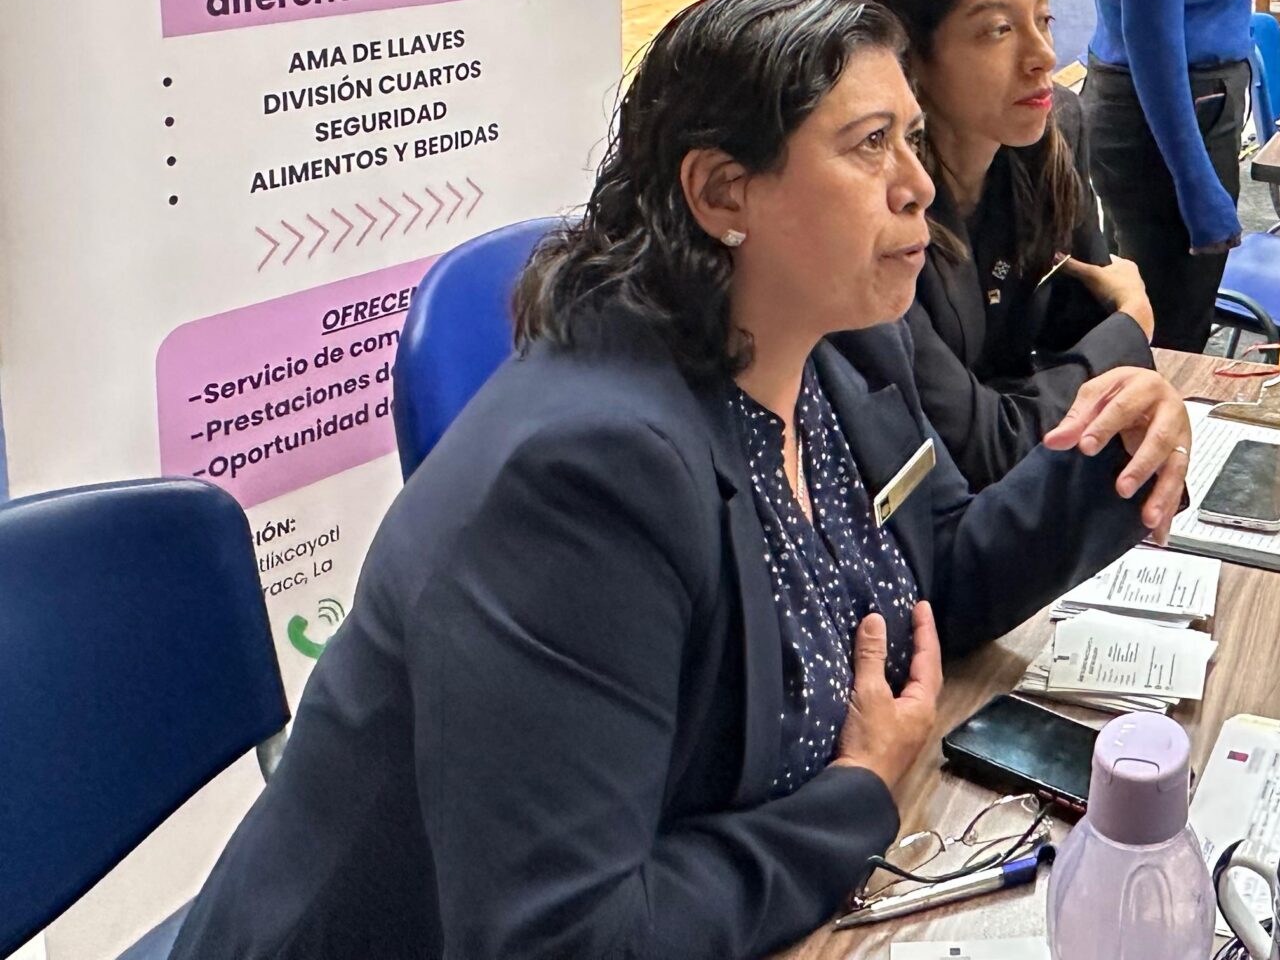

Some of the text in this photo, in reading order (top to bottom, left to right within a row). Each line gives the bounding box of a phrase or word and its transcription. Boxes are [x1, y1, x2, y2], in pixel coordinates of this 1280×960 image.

[288, 29, 466, 74] AMA DE LLAVES
[263, 60, 482, 115] DIVISIÓN CUARTOS
[314, 101, 448, 143] SEGURIDAD
[250, 122, 500, 193] ALIMENTOS Y BEDIDAS
[188, 329, 400, 404] -Servicio de com
[190, 361, 392, 442] -Prestaciones d
[192, 396, 391, 478] -Oportunidad d
[254, 518, 296, 547] IÓN:
[313, 559, 333, 578] La
